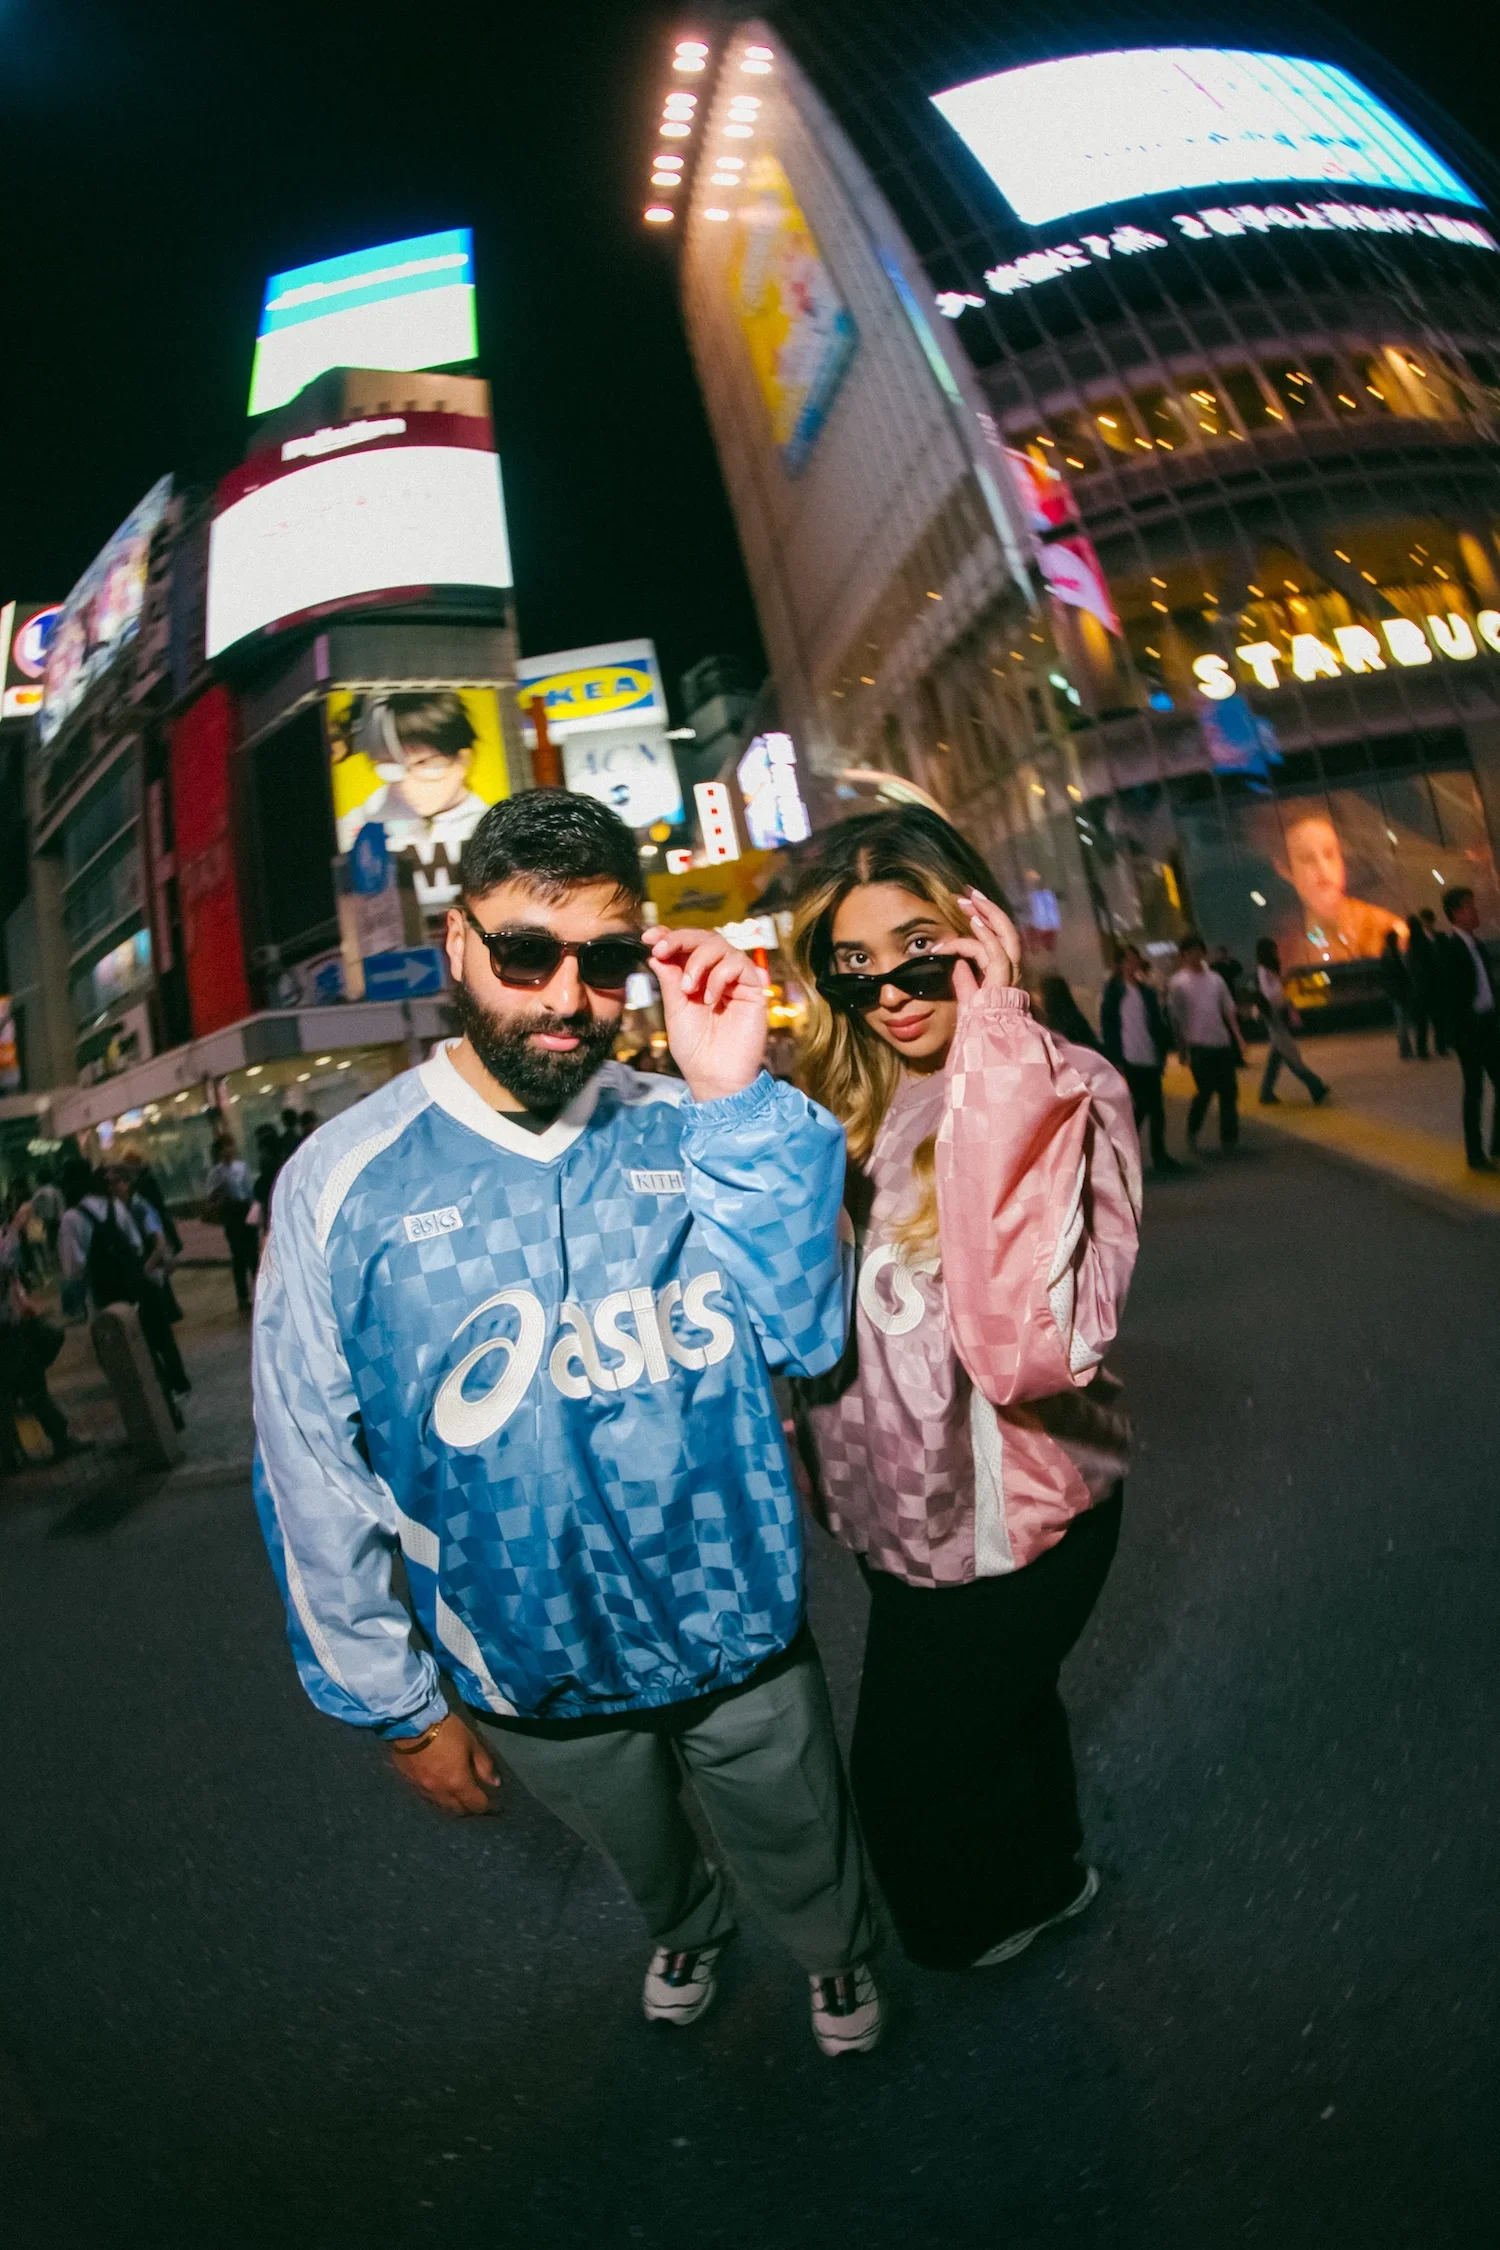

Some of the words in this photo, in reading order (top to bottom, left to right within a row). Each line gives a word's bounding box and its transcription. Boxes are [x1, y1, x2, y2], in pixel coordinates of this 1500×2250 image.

[544, 676, 640, 707] KEA
[636, 1173, 682, 1189] KITH
[411, 1209, 458, 1237] asics
[549, 1271, 735, 1399] asics
